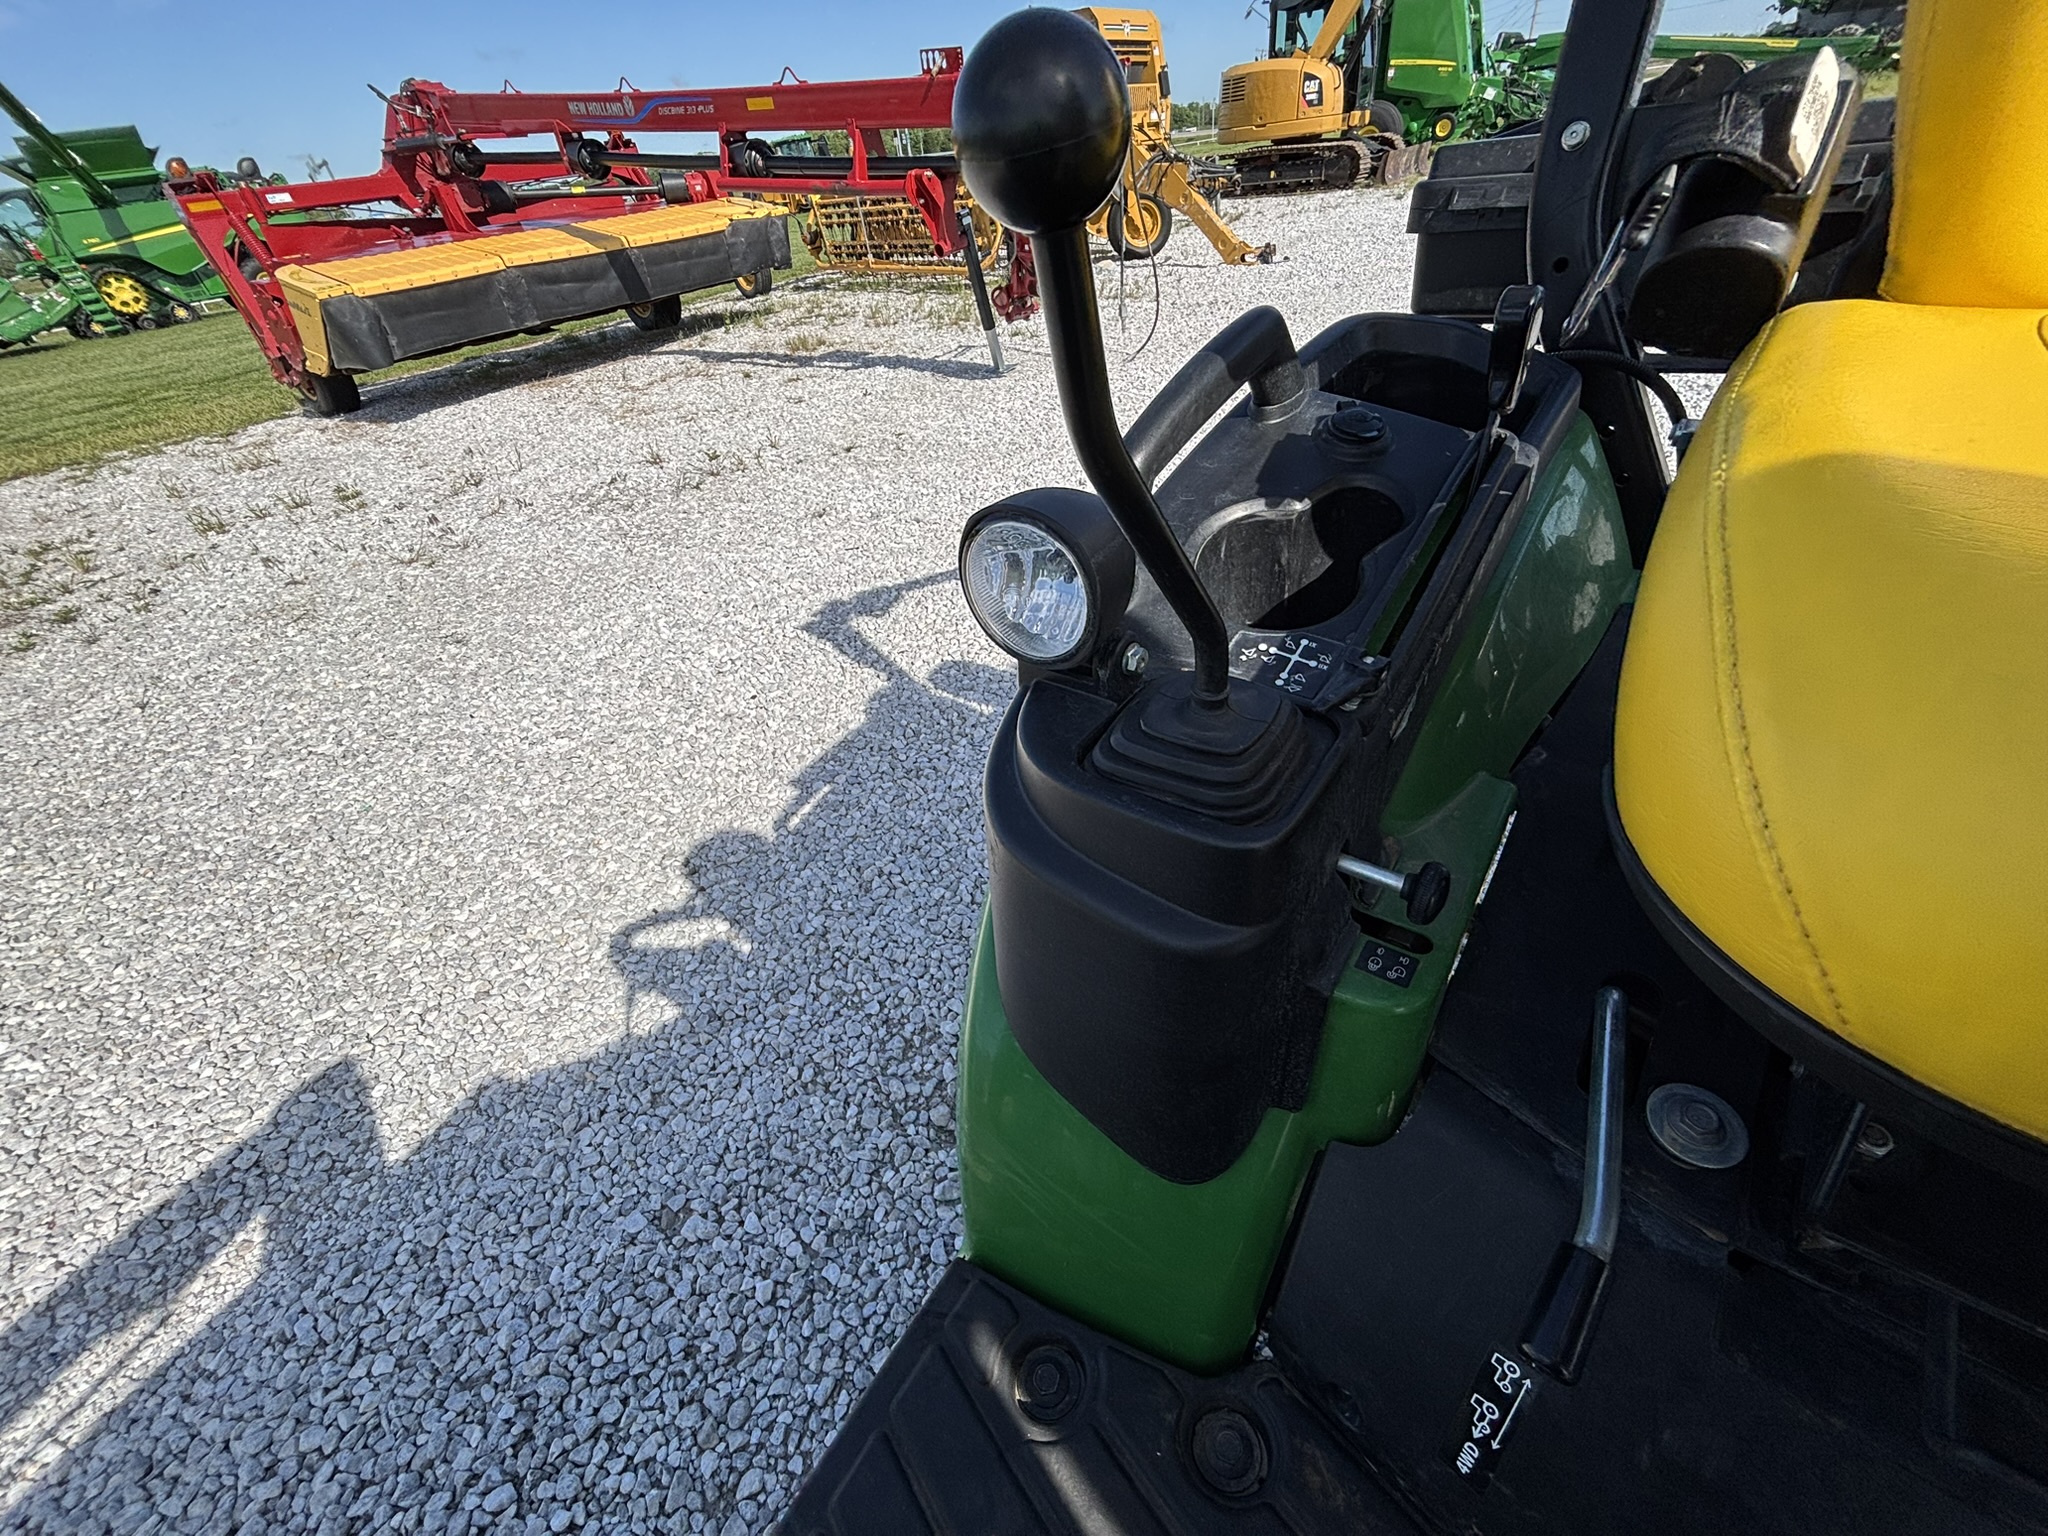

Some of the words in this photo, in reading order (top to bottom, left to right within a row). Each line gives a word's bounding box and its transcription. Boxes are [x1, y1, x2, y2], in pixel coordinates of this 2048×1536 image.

[1304, 79, 1319, 93] CAT
[568, 101, 587, 115] NEW
[587, 101, 624, 116] HOLLAND
[658, 106, 685, 116] DISCBINE
[686, 105, 697, 115] 313
[1456, 1441, 1479, 1474] 4WD
